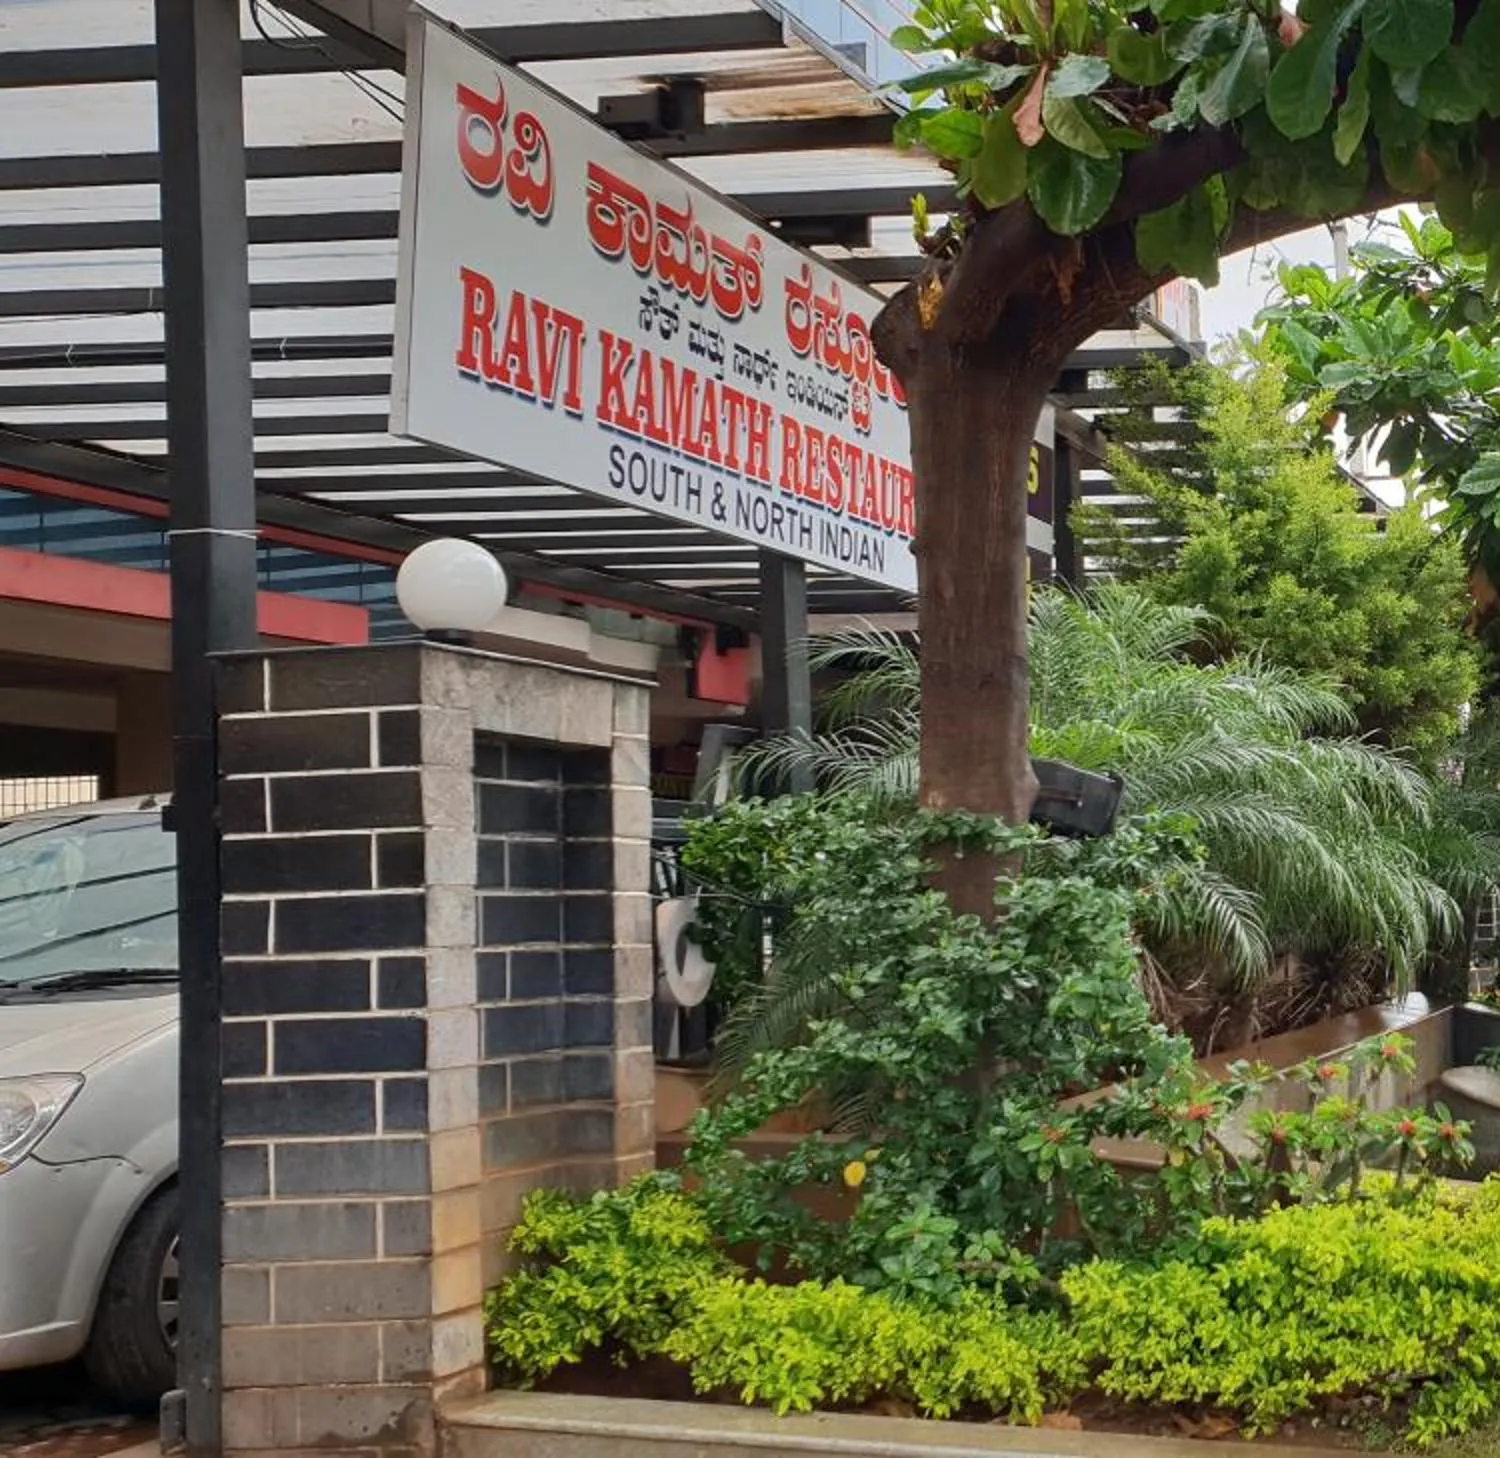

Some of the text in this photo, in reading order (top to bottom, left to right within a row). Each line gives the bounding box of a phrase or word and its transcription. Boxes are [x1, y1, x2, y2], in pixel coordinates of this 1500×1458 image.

[455, 70, 555, 222] ರವಿ
[586, 160, 763, 317] ಕಾಮತ್
[456, 265, 585, 418] RAVI
[596, 328, 773, 487] KAMATH
[608, 443, 885, 574] SOUTH & NORTH INDIAN
